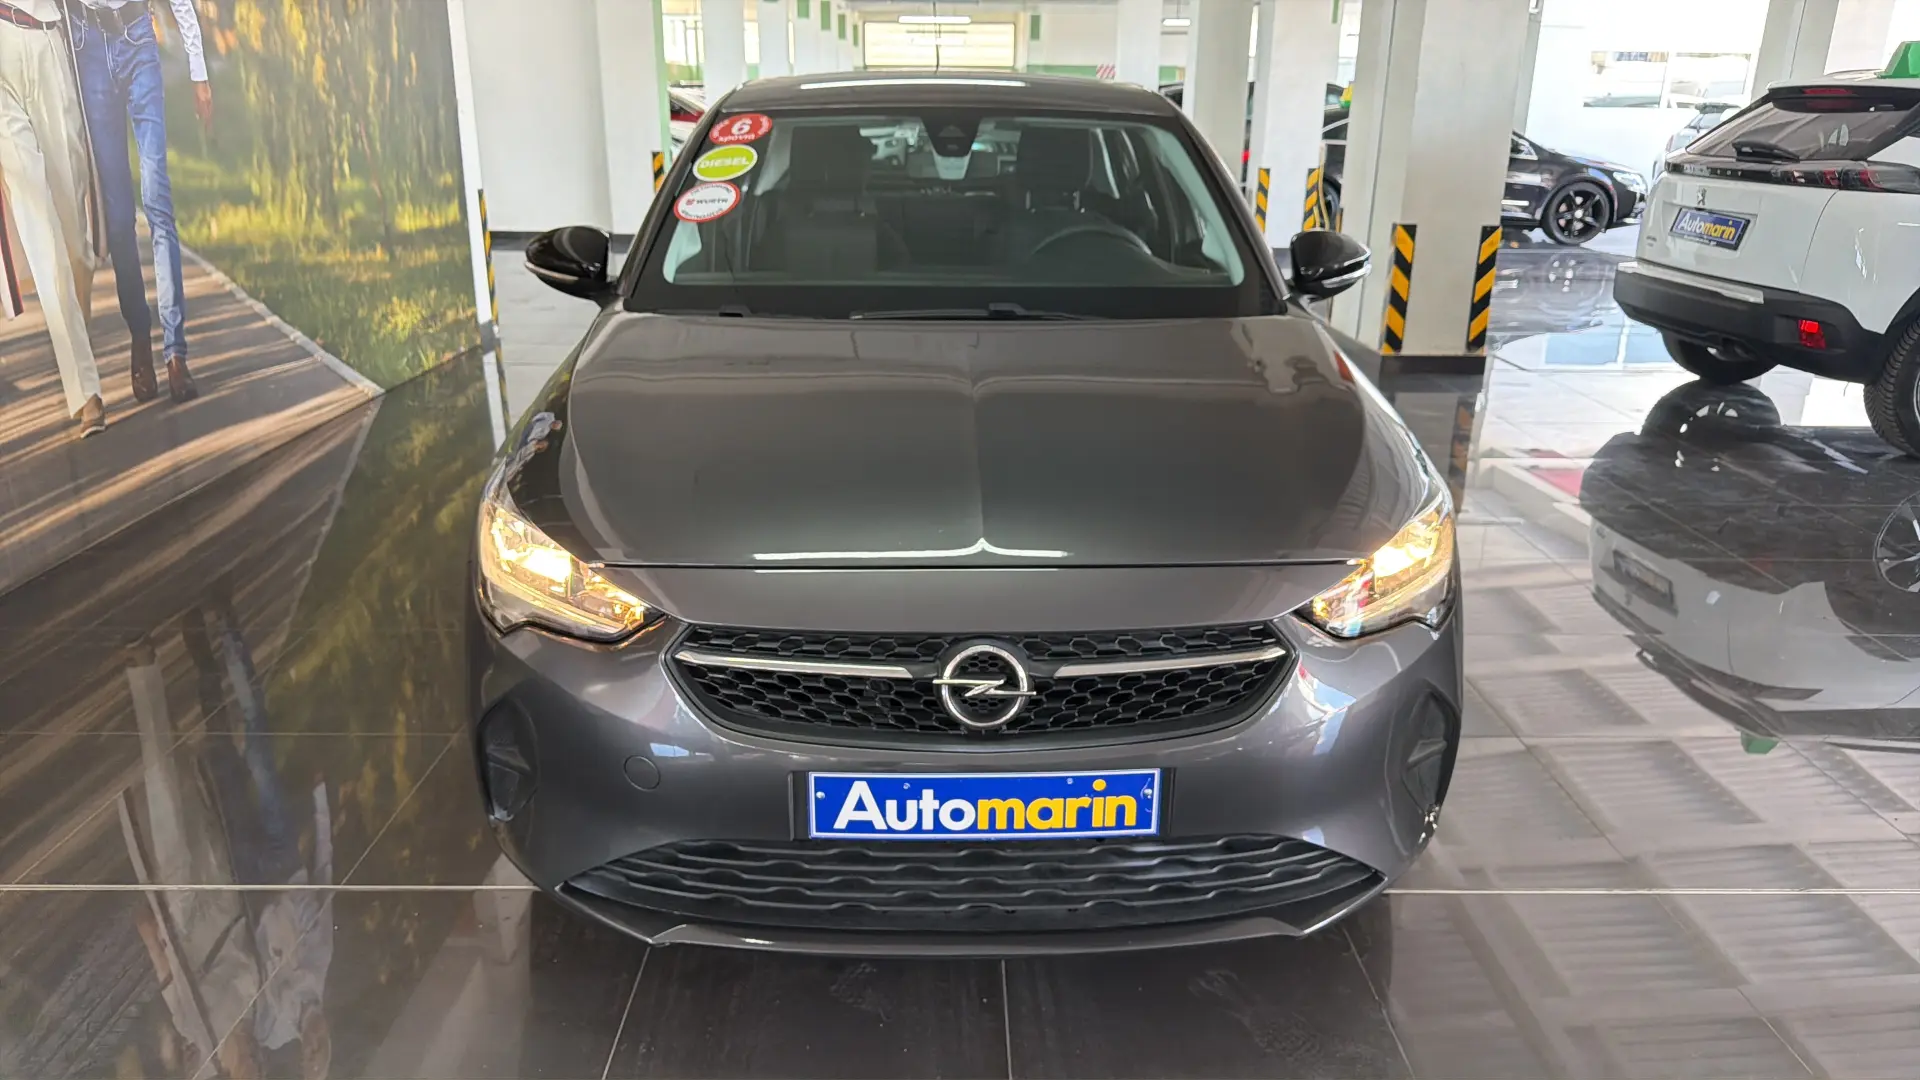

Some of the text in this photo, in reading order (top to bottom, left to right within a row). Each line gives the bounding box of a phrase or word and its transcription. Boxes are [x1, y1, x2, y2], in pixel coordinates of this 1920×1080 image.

[731, 118, 752, 135] 6
[699, 157, 749, 168] DIESEL
[1678, 213, 1736, 240] Automarin
[833, 779, 1137, 831] Automarin
